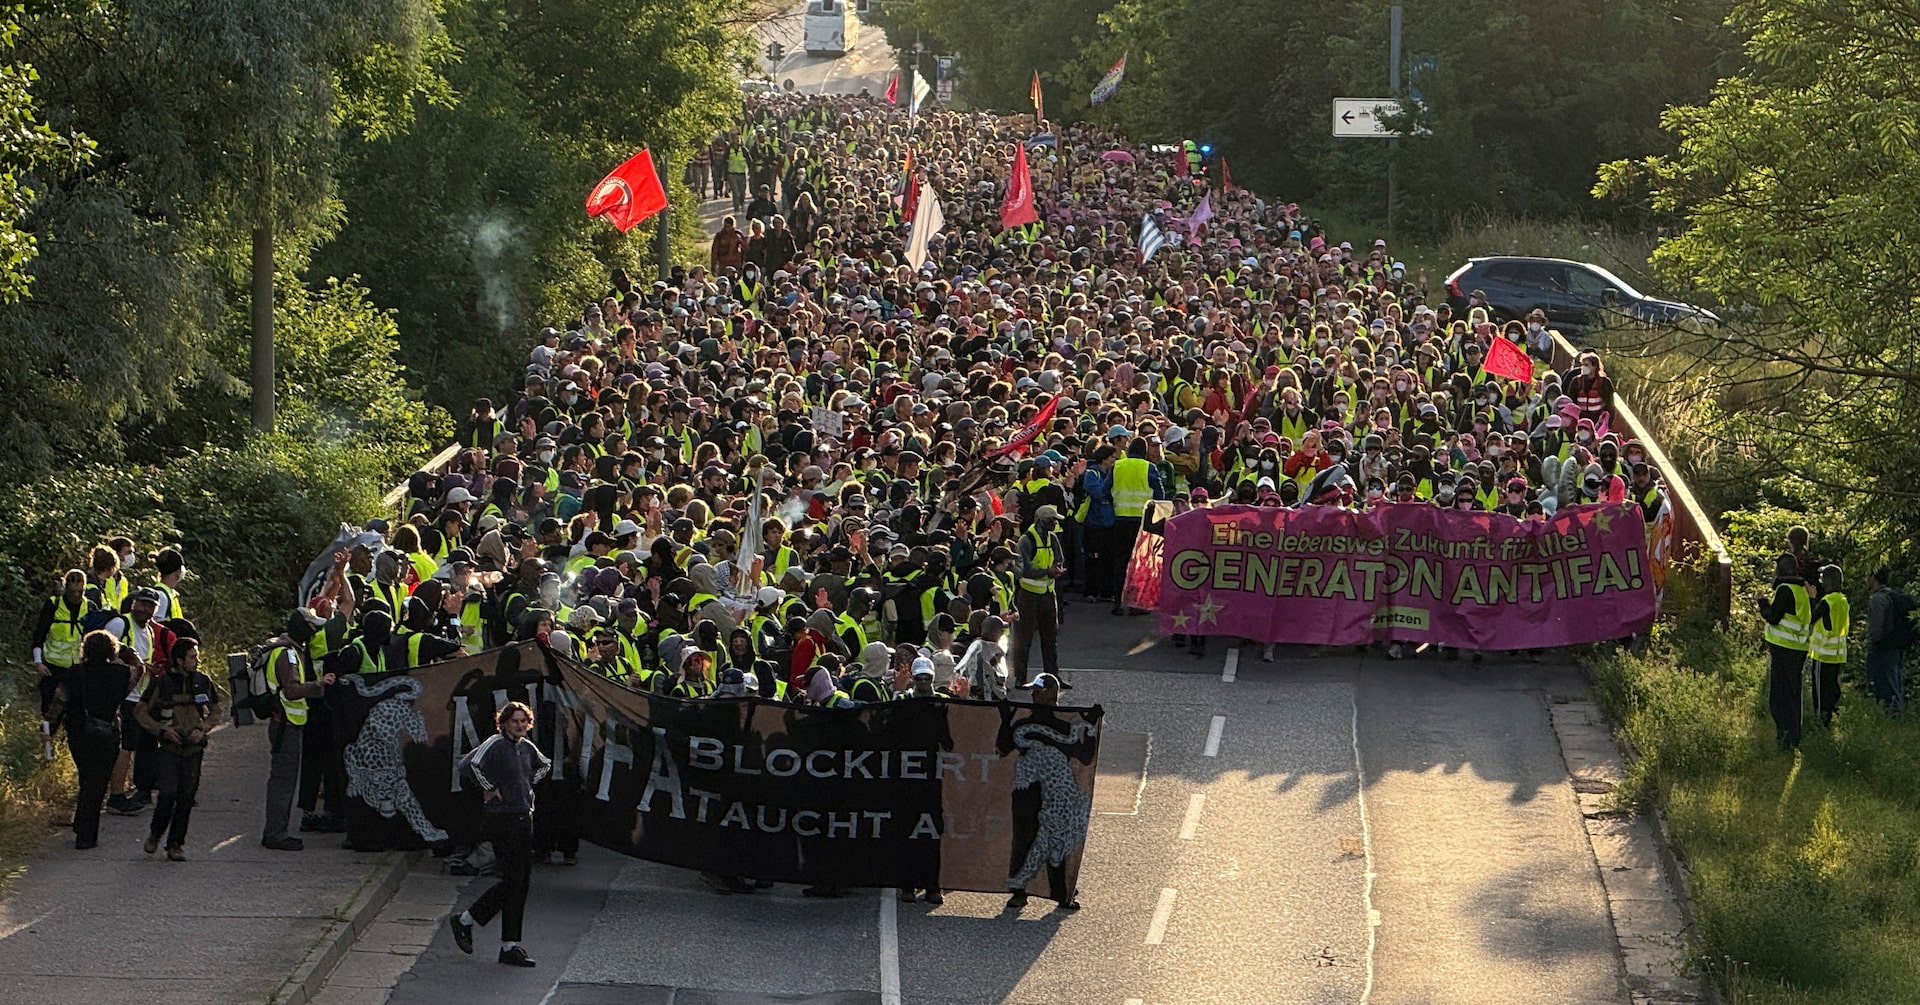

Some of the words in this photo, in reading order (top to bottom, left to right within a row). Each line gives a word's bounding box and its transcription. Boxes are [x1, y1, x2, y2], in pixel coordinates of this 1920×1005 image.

[1211, 521, 1272, 551] Eine
[1394, 527, 1493, 561] Zukunft
[1452, 549, 1644, 605] ANTIFA!
[689, 735, 1000, 784] BLOCKIERT
[689, 787, 893, 840] TAUCHT
